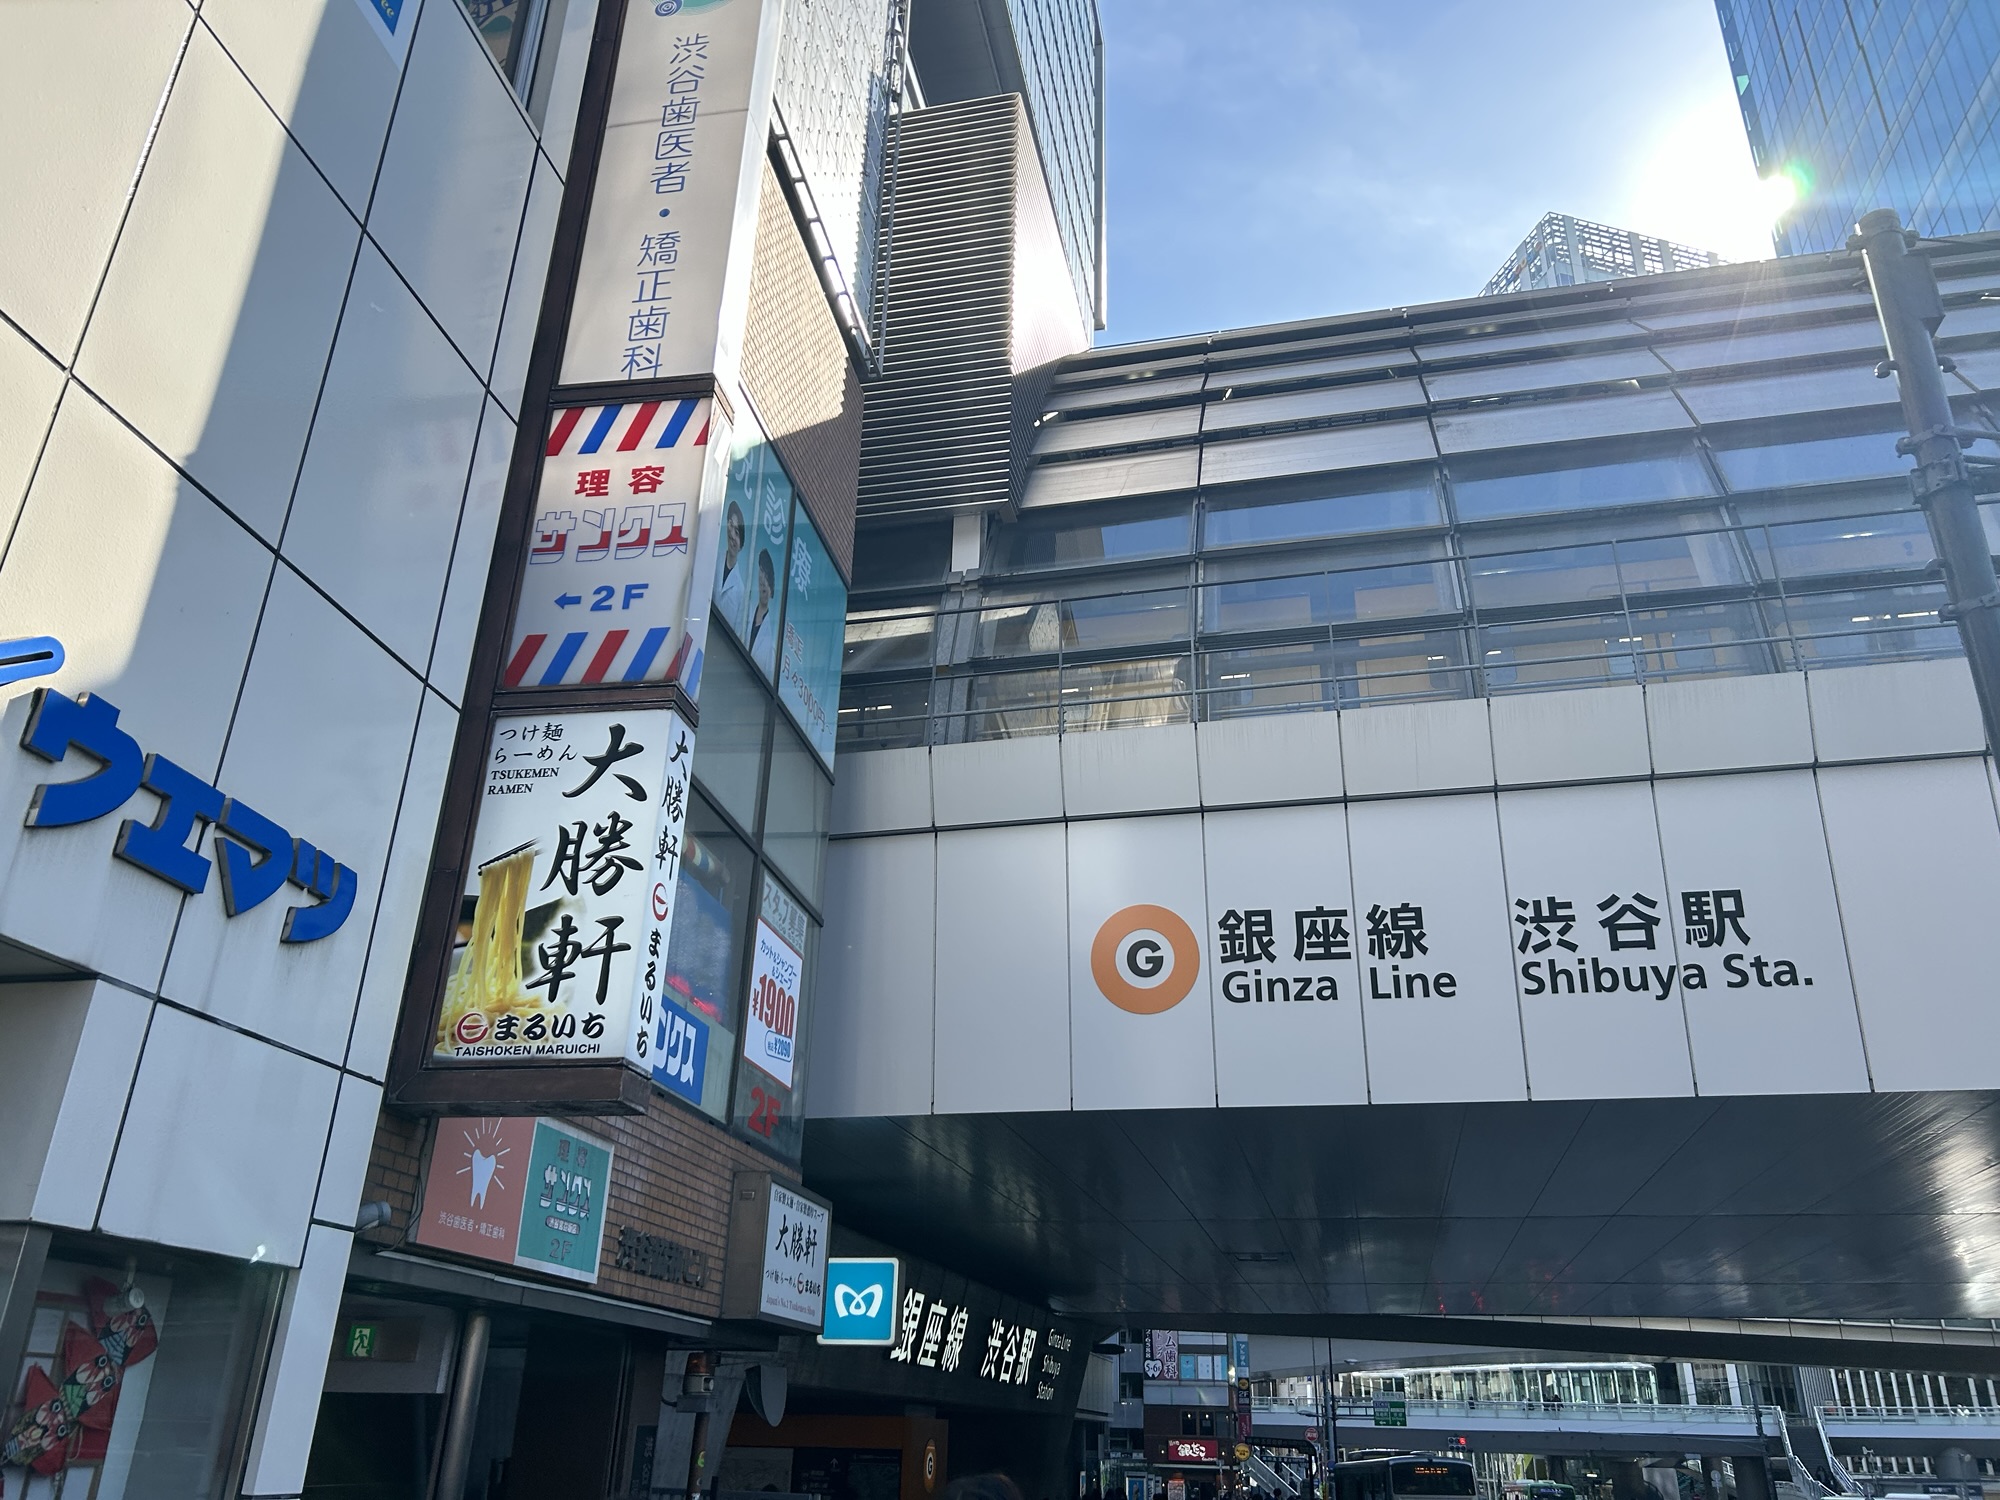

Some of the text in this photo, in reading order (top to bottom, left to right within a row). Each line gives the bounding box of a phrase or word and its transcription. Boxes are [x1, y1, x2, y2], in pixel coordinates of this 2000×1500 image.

[620, 33, 710, 381] 渋谷歯医者・矯正歯科
[574, 465, 666, 497] 理容
[529, 502, 689, 565] サンクス
[589, 583, 650, 612] 2F
[499, 722, 565, 742] つけ麺
[493, 744, 578, 764] らーめん
[487, 783, 534, 796] RAMEN
[490, 766, 560, 780] TSUKEMEN
[20, 686, 358, 943] ウエマツ
[655, 730, 689, 881] 大勝軒
[525, 722, 648, 1006] 大勝軒
[1217, 889, 1751, 964] 銀座線 渋谷駅
[1126, 939, 1164, 978] G
[635, 927, 663, 1059] まるいち
[1221, 953, 1814, 1003] Ginza Line Shibuya Sta.
[494, 1011, 606, 1041] まるいち
[454, 1042, 601, 1058] TAISHOKEN MARUICHI
[747, 1085, 781, 1138] 2F
[549, 1238, 573, 1261] 2F
[774, 1213, 818, 1268] 大勝軒
[889, 1287, 1038, 1385] 銀座線 渋谷駅
[1047, 1328, 1073, 1352] Ginza Line
[1041, 1354, 1062, 1380] Shibuya
[1036, 1380, 1055, 1401] Station
